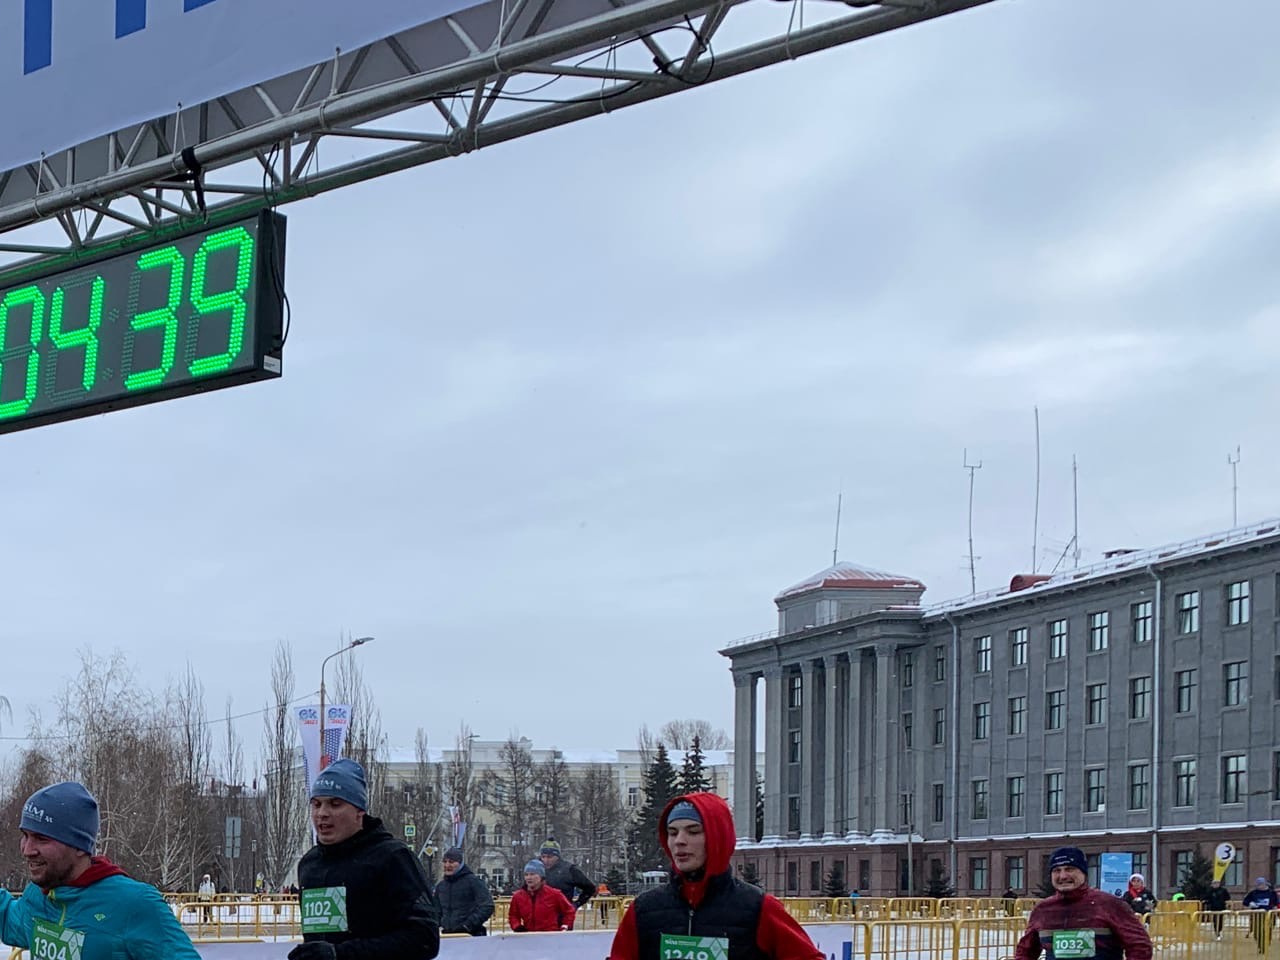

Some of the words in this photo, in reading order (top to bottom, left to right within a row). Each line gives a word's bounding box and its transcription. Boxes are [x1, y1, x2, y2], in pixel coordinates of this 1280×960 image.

[1221, 845, 1232, 860] 3
[304, 901, 332, 917] 1102
[1055, 939, 1085, 950] 1032
